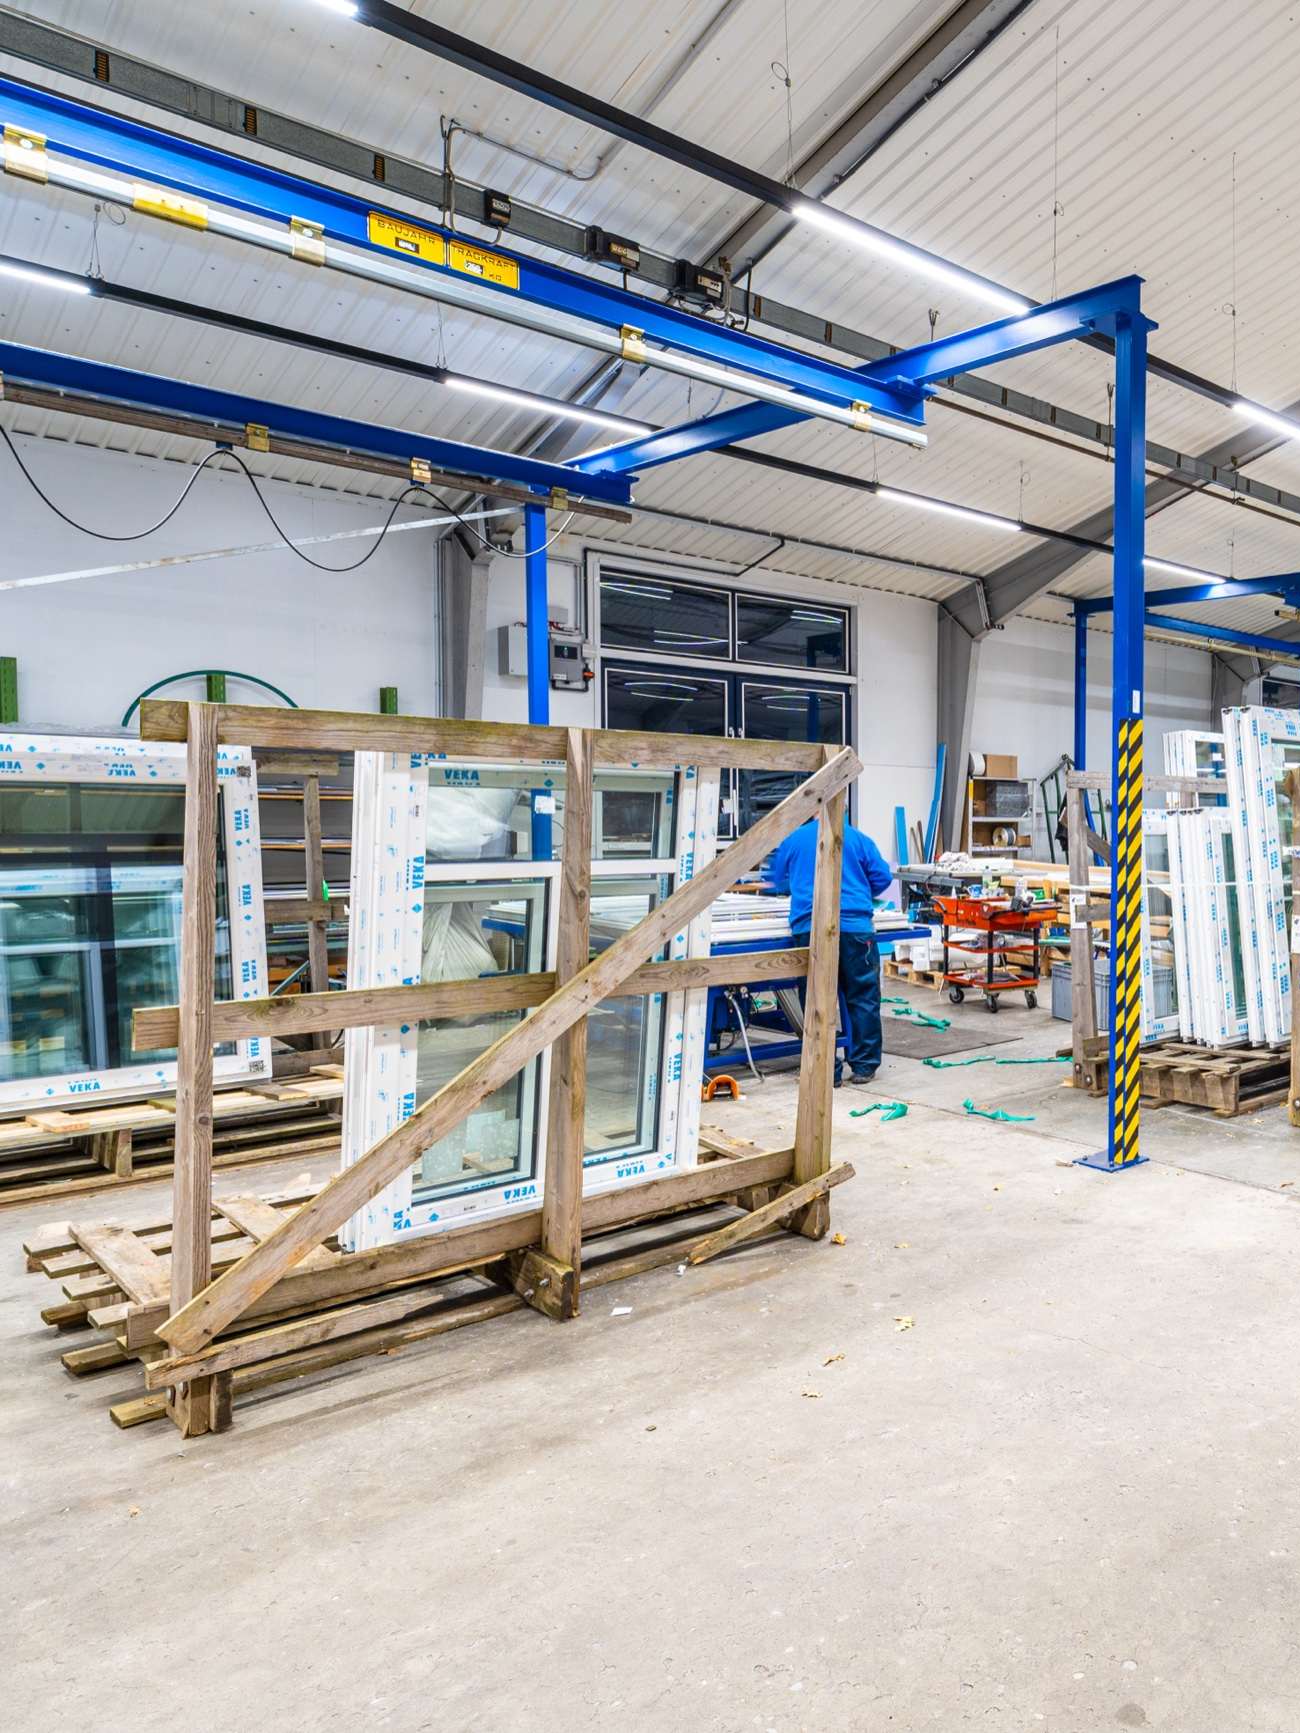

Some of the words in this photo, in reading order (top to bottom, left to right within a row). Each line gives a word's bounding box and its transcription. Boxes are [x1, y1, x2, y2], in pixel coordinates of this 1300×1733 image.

[377, 219, 436, 245] BAUJAHR
[444, 768, 481, 781] VEKA
[234, 810, 243, 832] VEKA
[412, 856, 425, 890] VEKA
[242, 884, 252, 906] VEKA
[242, 961, 250, 983] VEKA
[673, 1051, 682, 1081] VEKA
[69, 1081, 101, 1093] VEKA
[402, 1092, 415, 1121] EKA
[617, 1164, 646, 1178] VEKA
[503, 1184, 536, 1200] VEKA
